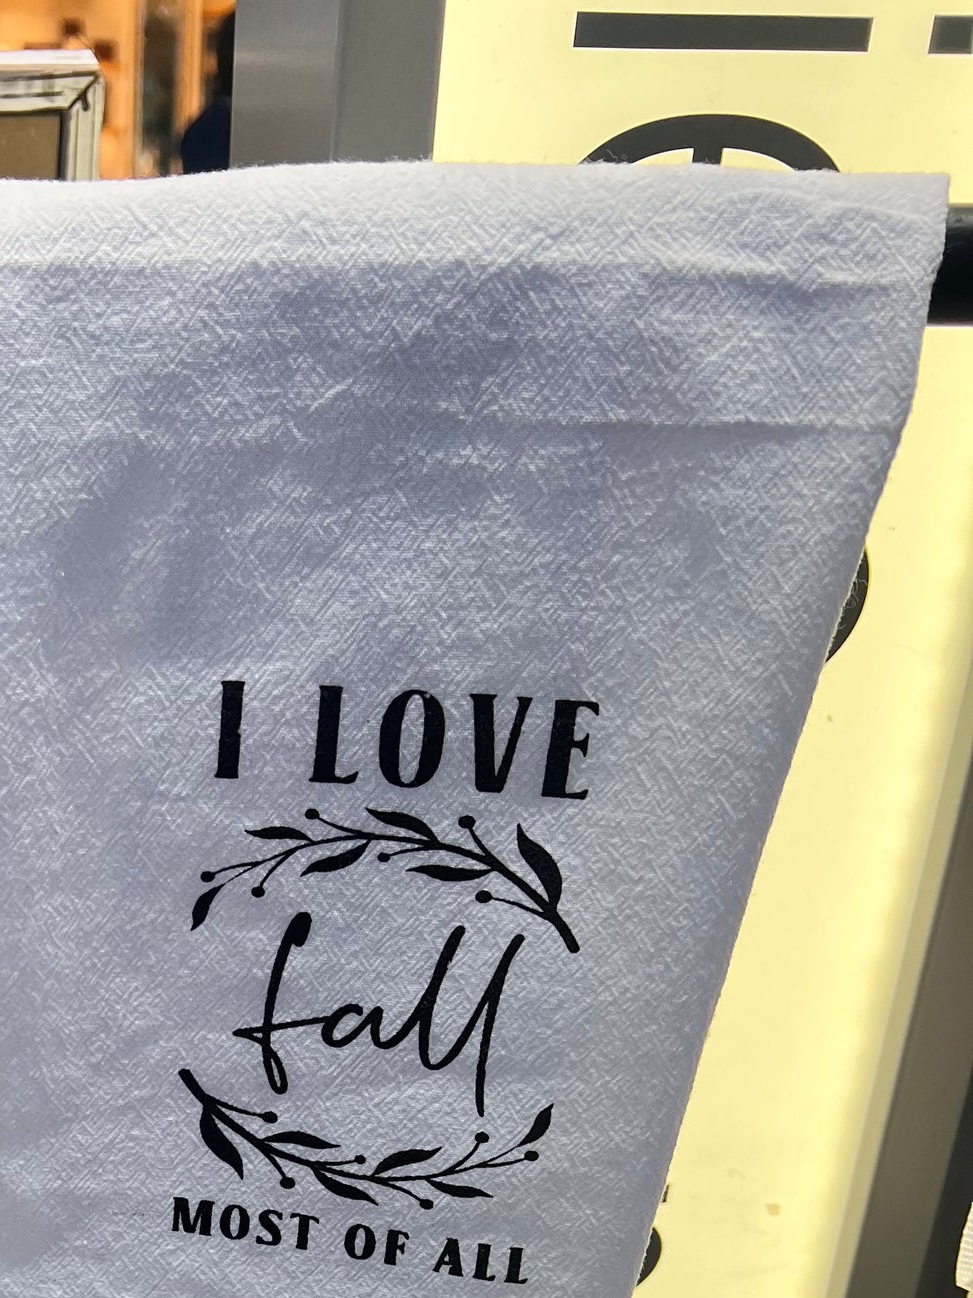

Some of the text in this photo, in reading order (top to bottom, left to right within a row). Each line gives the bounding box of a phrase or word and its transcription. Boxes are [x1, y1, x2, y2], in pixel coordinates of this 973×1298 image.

[214, 680, 600, 800] I LOVE
[232, 911, 525, 1118] fall
[171, 1197, 528, 1285] MOST OF ALL
